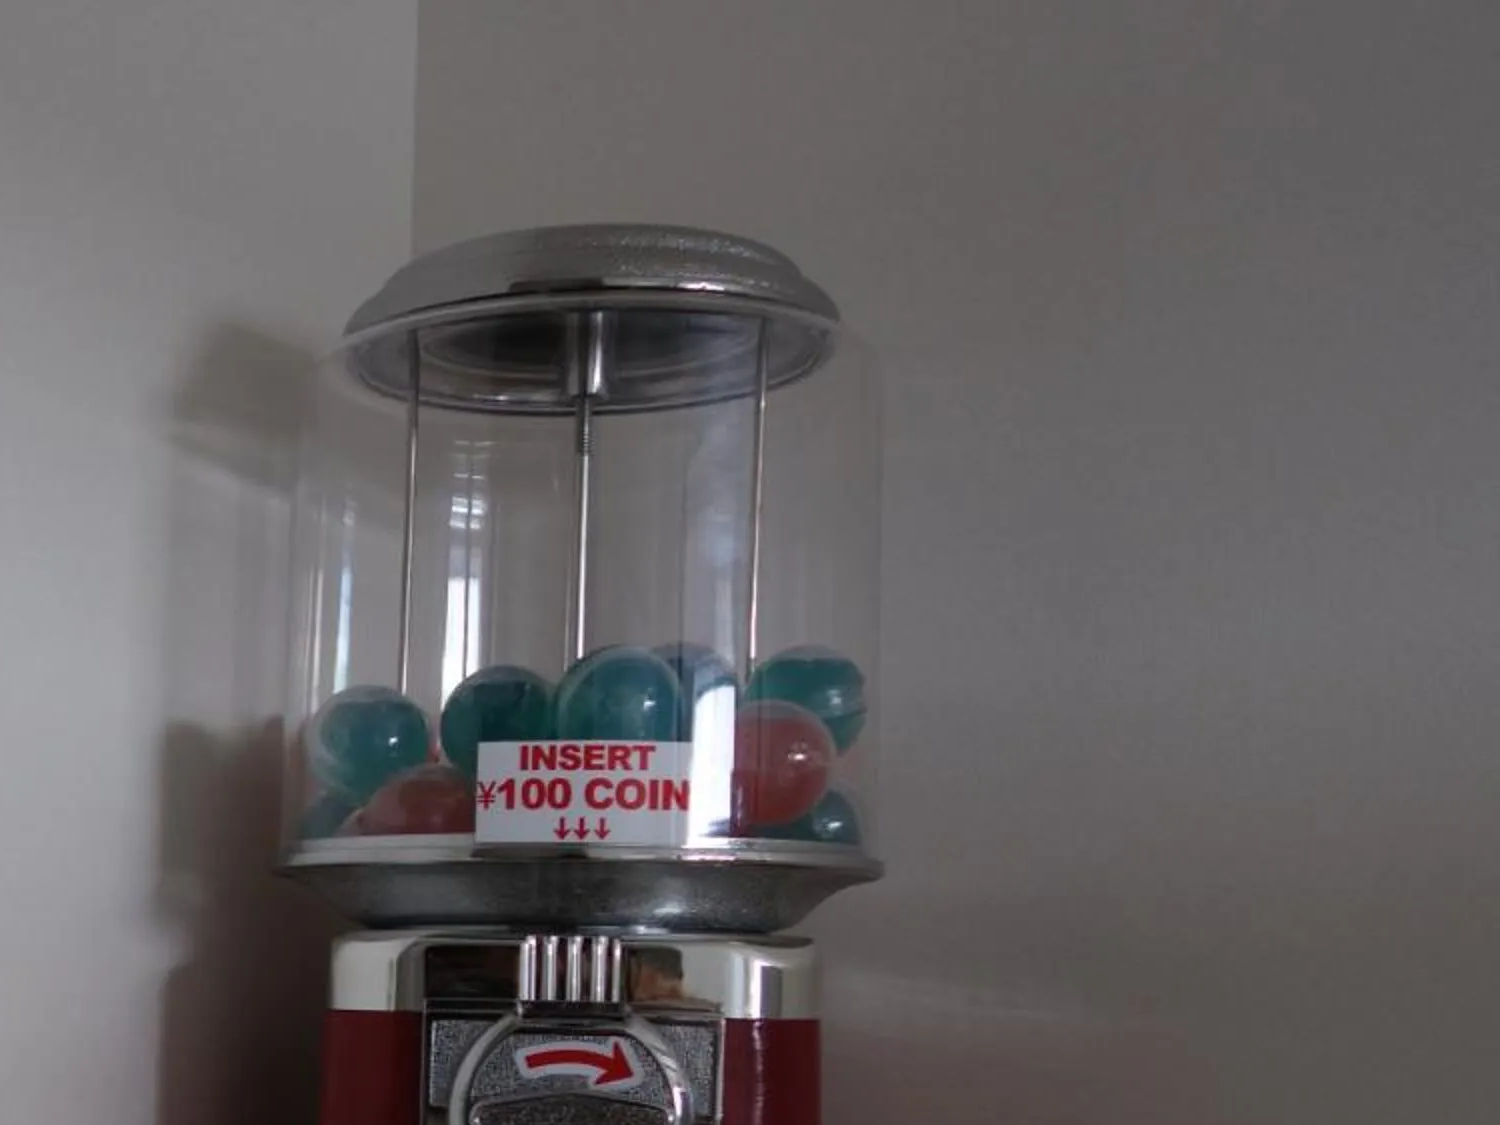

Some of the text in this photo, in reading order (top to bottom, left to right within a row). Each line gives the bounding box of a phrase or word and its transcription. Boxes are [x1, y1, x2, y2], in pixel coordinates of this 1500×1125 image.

[519, 745, 656, 771] INSERT
[476, 777, 690, 811] ¥100 COIN
